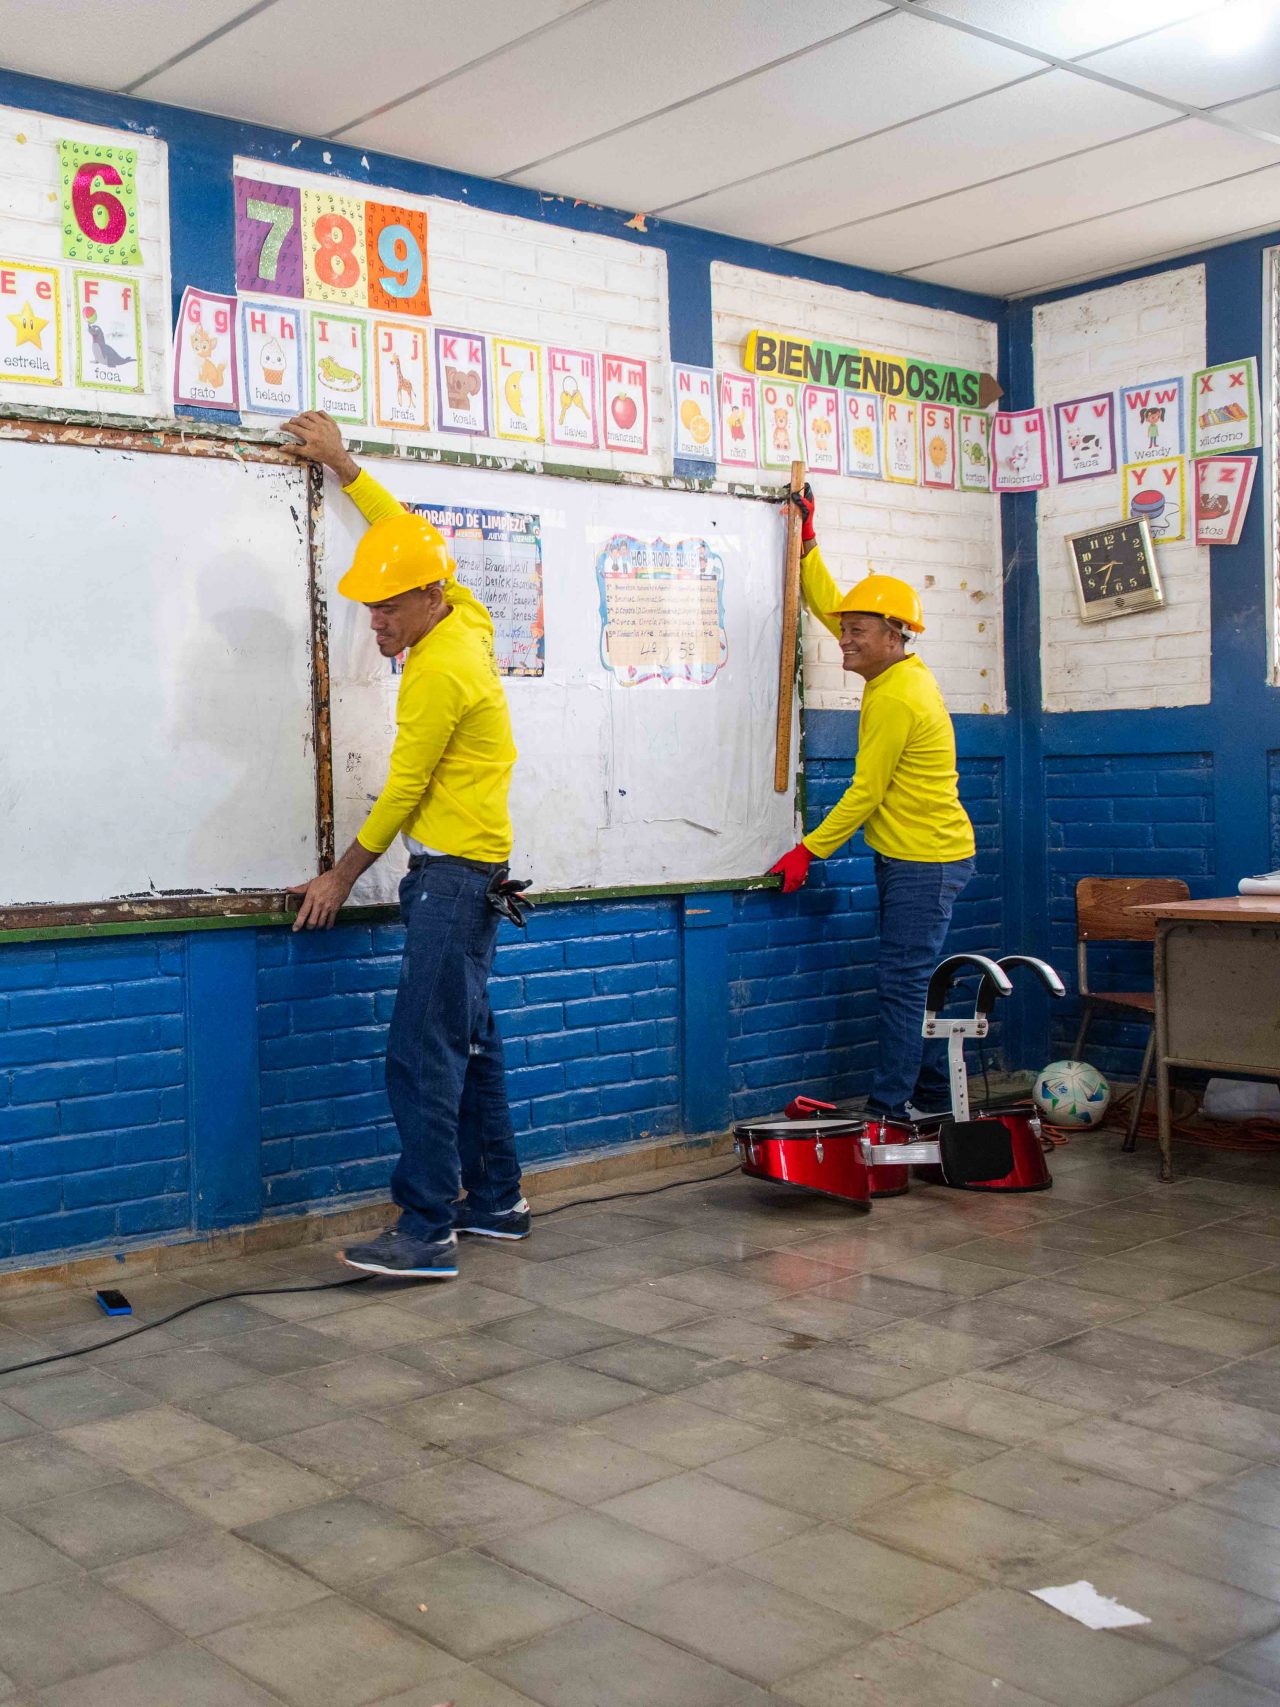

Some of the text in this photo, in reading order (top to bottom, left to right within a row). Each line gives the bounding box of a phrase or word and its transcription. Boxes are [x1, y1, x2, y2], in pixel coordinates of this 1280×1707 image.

[72, 162, 127, 245] 6
[246, 197, 294, 281] 7
[314, 213, 361, 289] 8
[378, 224, 423, 298] 9
[0, 270, 52, 300] E e
[84, 280, 131, 310] F f
[187, 301, 228, 333] G g
[251, 311, 294, 340] H h
[318, 321, 329, 342] I
[382, 332, 419, 360] J j
[443, 337, 480, 363] K k
[4, 355, 51, 371] estrella
[501, 347, 511, 367] L
[552, 354, 571, 372] LL
[94, 368, 121, 382] foca
[607, 363, 642, 386] M m
[756, 335, 979, 406] BIENVENIDOS/AS
[190, 386, 216, 399] gato
[679, 372, 710, 395] N n
[1200, 372, 1245, 395] X x
[255, 387, 291, 403] helado
[722, 380, 752, 407] Ñ ñ
[764, 386, 794, 407] O o
[1126, 388, 1177, 410] W w
[322, 397, 357, 412] iguana
[808, 392, 835, 417] P p
[848, 398, 875, 422] Q q
[889, 404, 913, 423] R r
[1063, 403, 1107, 423] V v
[452, 412, 477, 426] koala
[510, 418, 528, 431] luna
[927, 411, 950, 429] S s
[963, 416, 985, 434] T t
[1000, 419, 1039, 435] U u
[1134, 446, 1171, 460] Wendy
[1073, 460, 1099, 470] vaca
[1131, 467, 1177, 486] Y y
[1217, 467, 1238, 483] z
[466, 513, 480, 528] DE
[482, 515, 528, 533] LIMPIEZA
[1199, 526, 1224, 536] atos
[1104, 534, 1115, 545] 12
[1121, 531, 1127, 541] 1
[1151, 528, 1166, 539] yo
[1090, 540, 1099, 550] 11
[1132, 538, 1140, 548] 2
[1082, 552, 1092, 562] 10
[1136, 552, 1144, 562] 3
[1084, 565, 1092, 575] 9
[1139, 566, 1146, 575] 4
[1088, 578, 1096, 588] 8
[1100, 585, 1107, 595] 7
[1115, 582, 1123, 592] 6
[1129, 578, 1137, 587] 5
